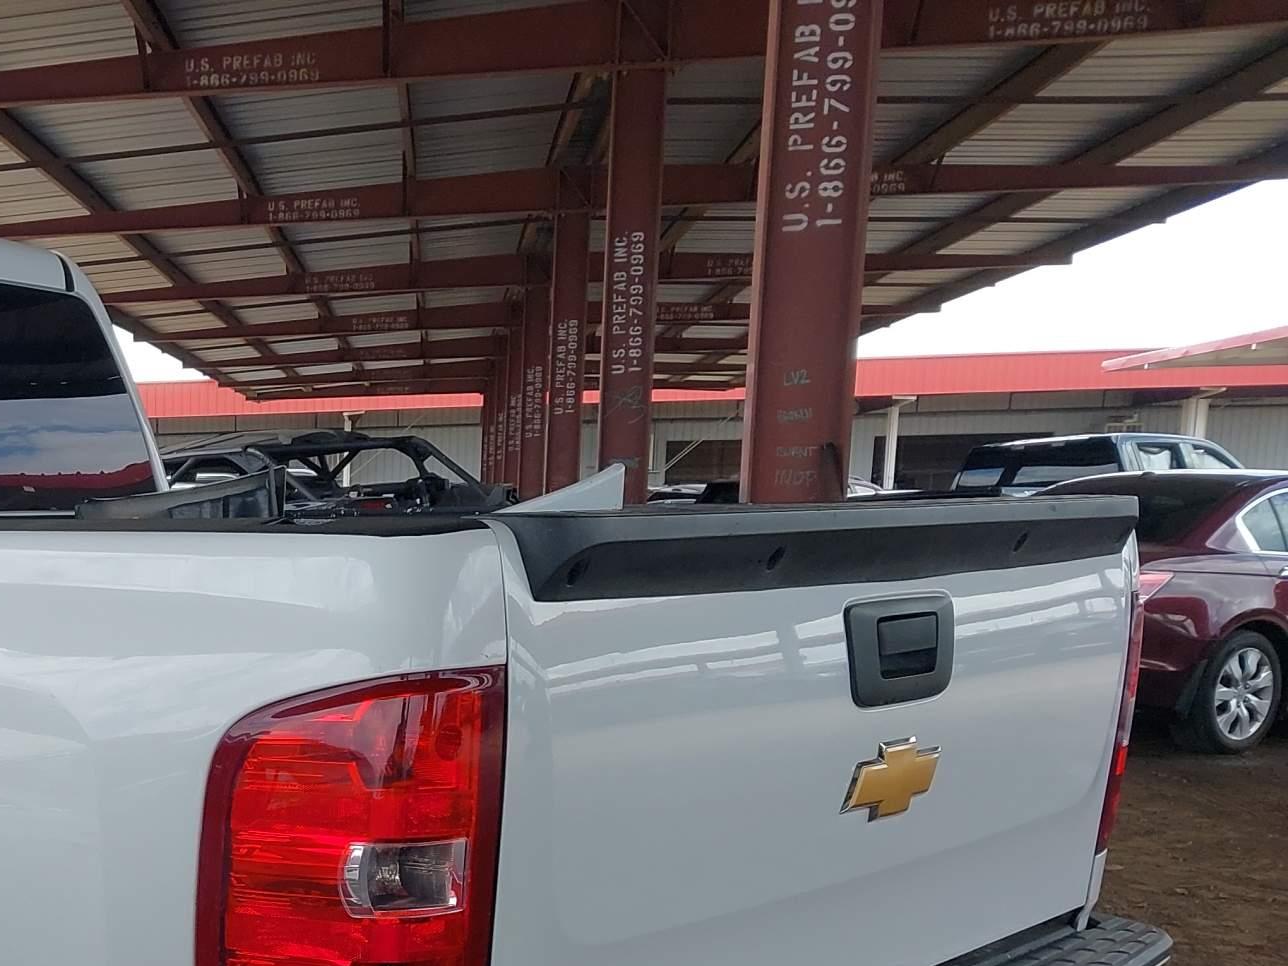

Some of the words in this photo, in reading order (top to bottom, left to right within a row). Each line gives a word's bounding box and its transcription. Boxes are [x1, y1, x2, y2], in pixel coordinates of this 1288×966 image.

[989, 5, 1023, 22] U.S.
[1033, 1, 1105, 17] PREFAB
[185, 57, 214, 73] U.S.
[223, 53, 283, 70] PREFAB
[185, 68, 320, 88] 1-866-799-0969
[788, 24, 822, 151] PREFAB
[781, 171, 812, 233] U.S.
[614, 231, 629, 263] INC.
[612, 270, 628, 334] PREFAB
[628, 231, 646, 373] 1-866-799-0969
[554, 345, 568, 389] PREFAB
[612, 343, 626, 375] U.S.
